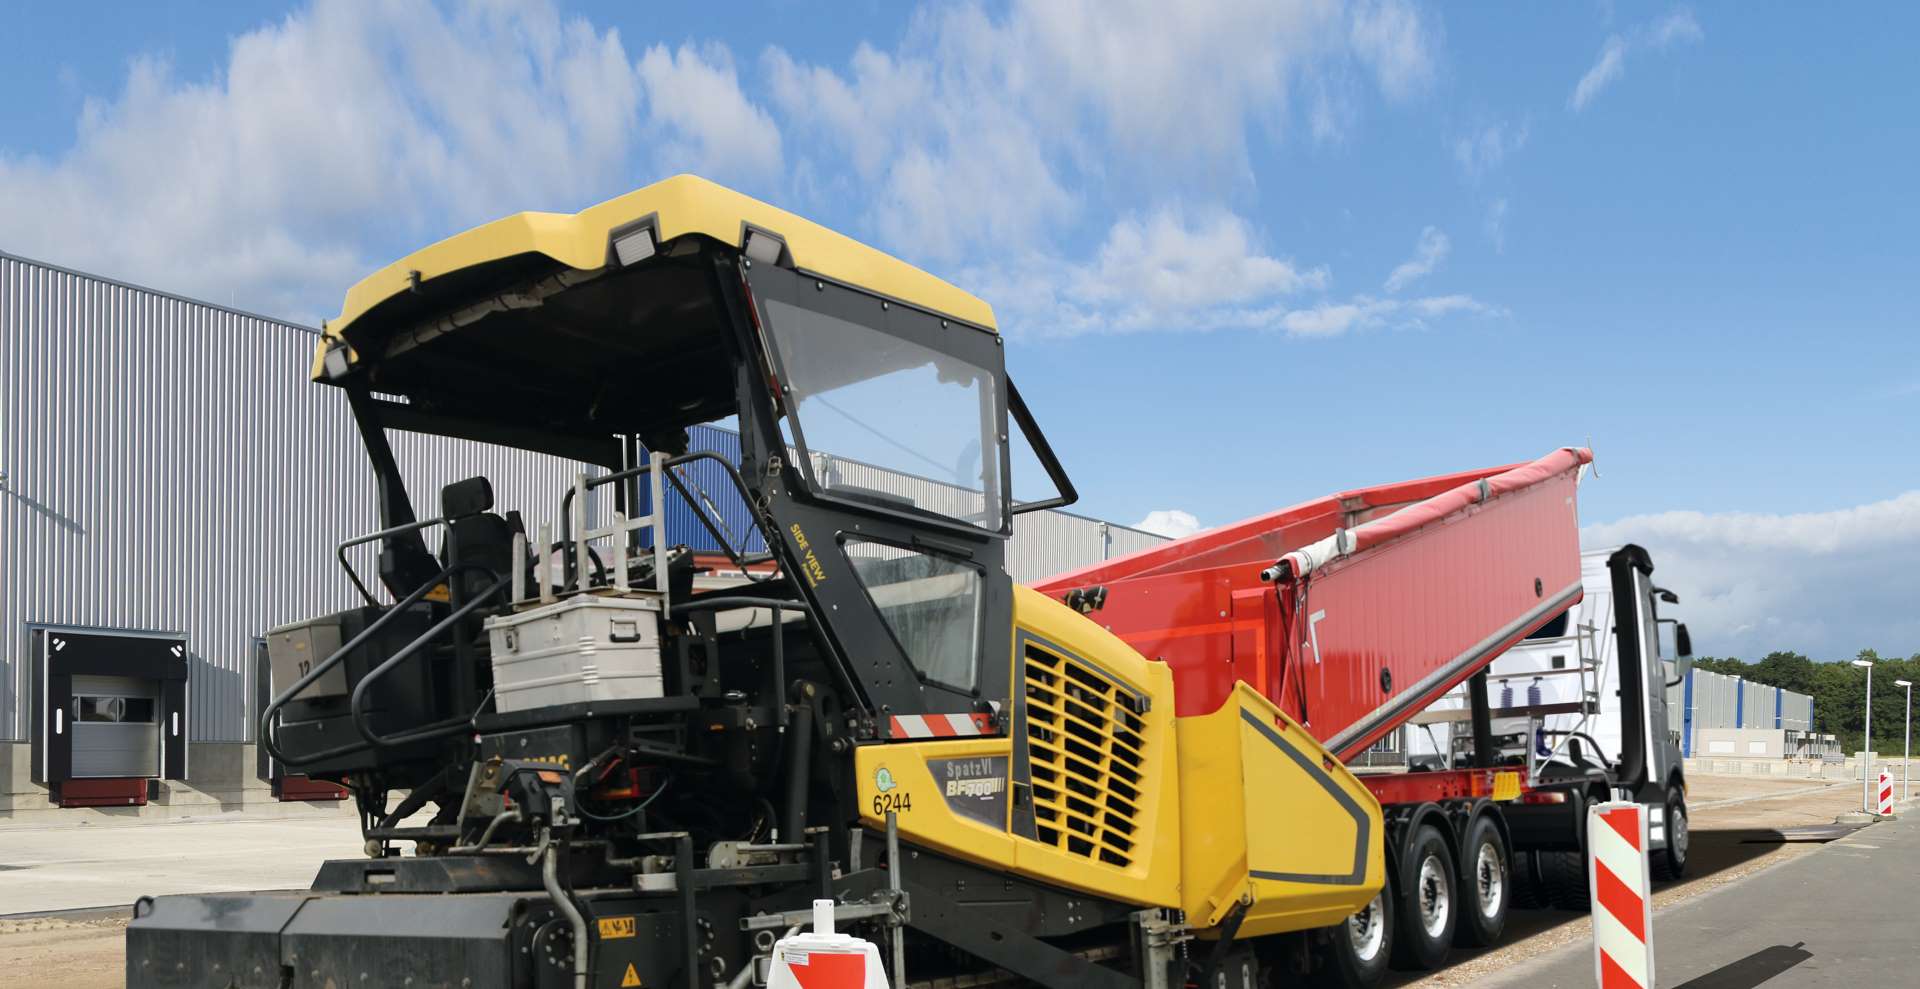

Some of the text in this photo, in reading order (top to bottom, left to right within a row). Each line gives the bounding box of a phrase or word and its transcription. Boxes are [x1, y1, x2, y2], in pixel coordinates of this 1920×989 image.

[790, 523, 809, 550] SIDE
[805, 549, 826, 580] VIEW
[873, 793, 911, 816] 6244
